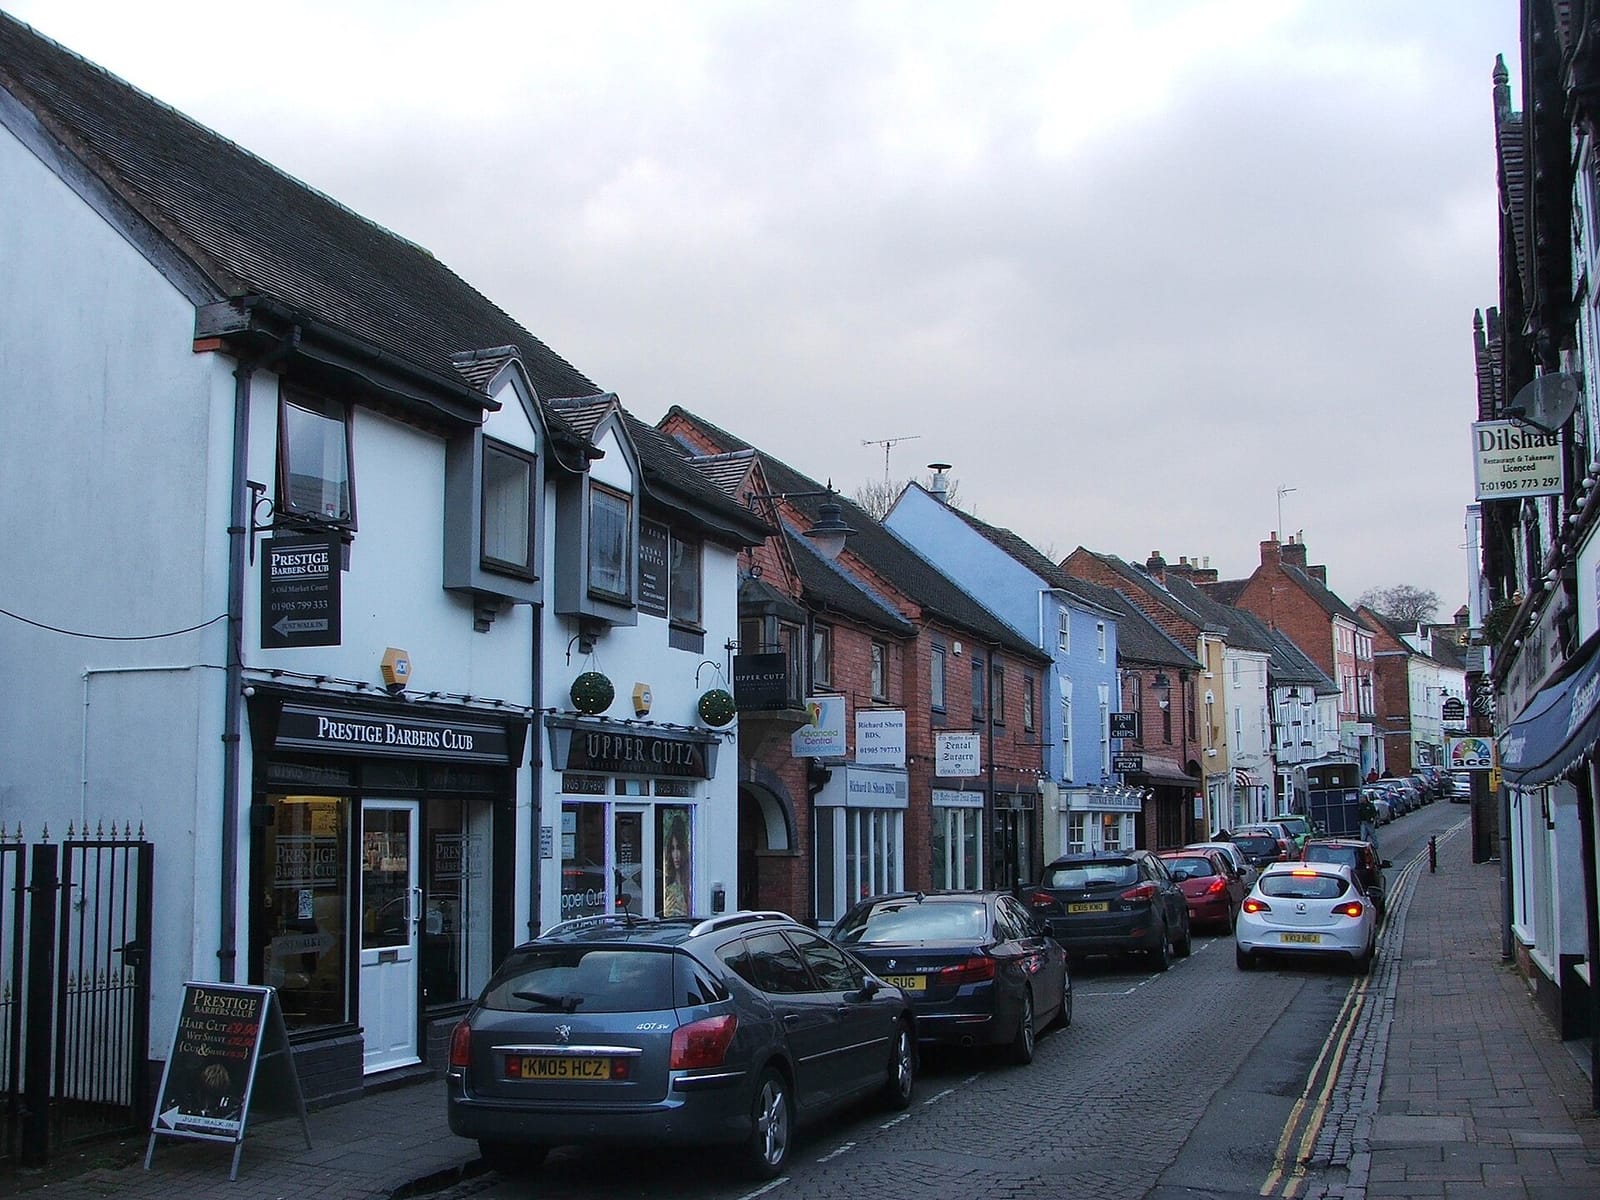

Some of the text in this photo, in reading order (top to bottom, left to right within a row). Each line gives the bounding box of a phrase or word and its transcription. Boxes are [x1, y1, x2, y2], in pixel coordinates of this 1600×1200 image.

[1521, 479, 1538, 488] 773
[1542, 477, 1560, 487] 297
[271, 552, 329, 567] PRESTIGE
[271, 563, 329, 576] BARBERS CLUB
[271, 602, 296, 611] 01905
[312, 600, 328, 609] 333
[763, 673, 785, 681] CUTZ
[317, 717, 474, 751] PRESTIGE BARBERS CLUB
[799, 729, 839, 738] Advanced
[804, 737, 833, 745] Central
[944, 741, 971, 750] Dental
[586, 733, 646, 762] UPPER
[651, 740, 694, 766] CUTZ
[1453, 759, 1491, 767] ace
[849, 780, 867, 792] Richard
[561, 892, 585, 909] pper
[892, 977, 916, 988] SUG
[193, 990, 257, 1011] PRESTIGE
[194, 1006, 253, 1018] BARBERS CLUB
[180, 1017, 204, 1030] HAIR
[206, 1019, 228, 1032] CUT
[635, 1022, 656, 1030] 407
[527, 1060, 603, 1077] KM05 HCZ
